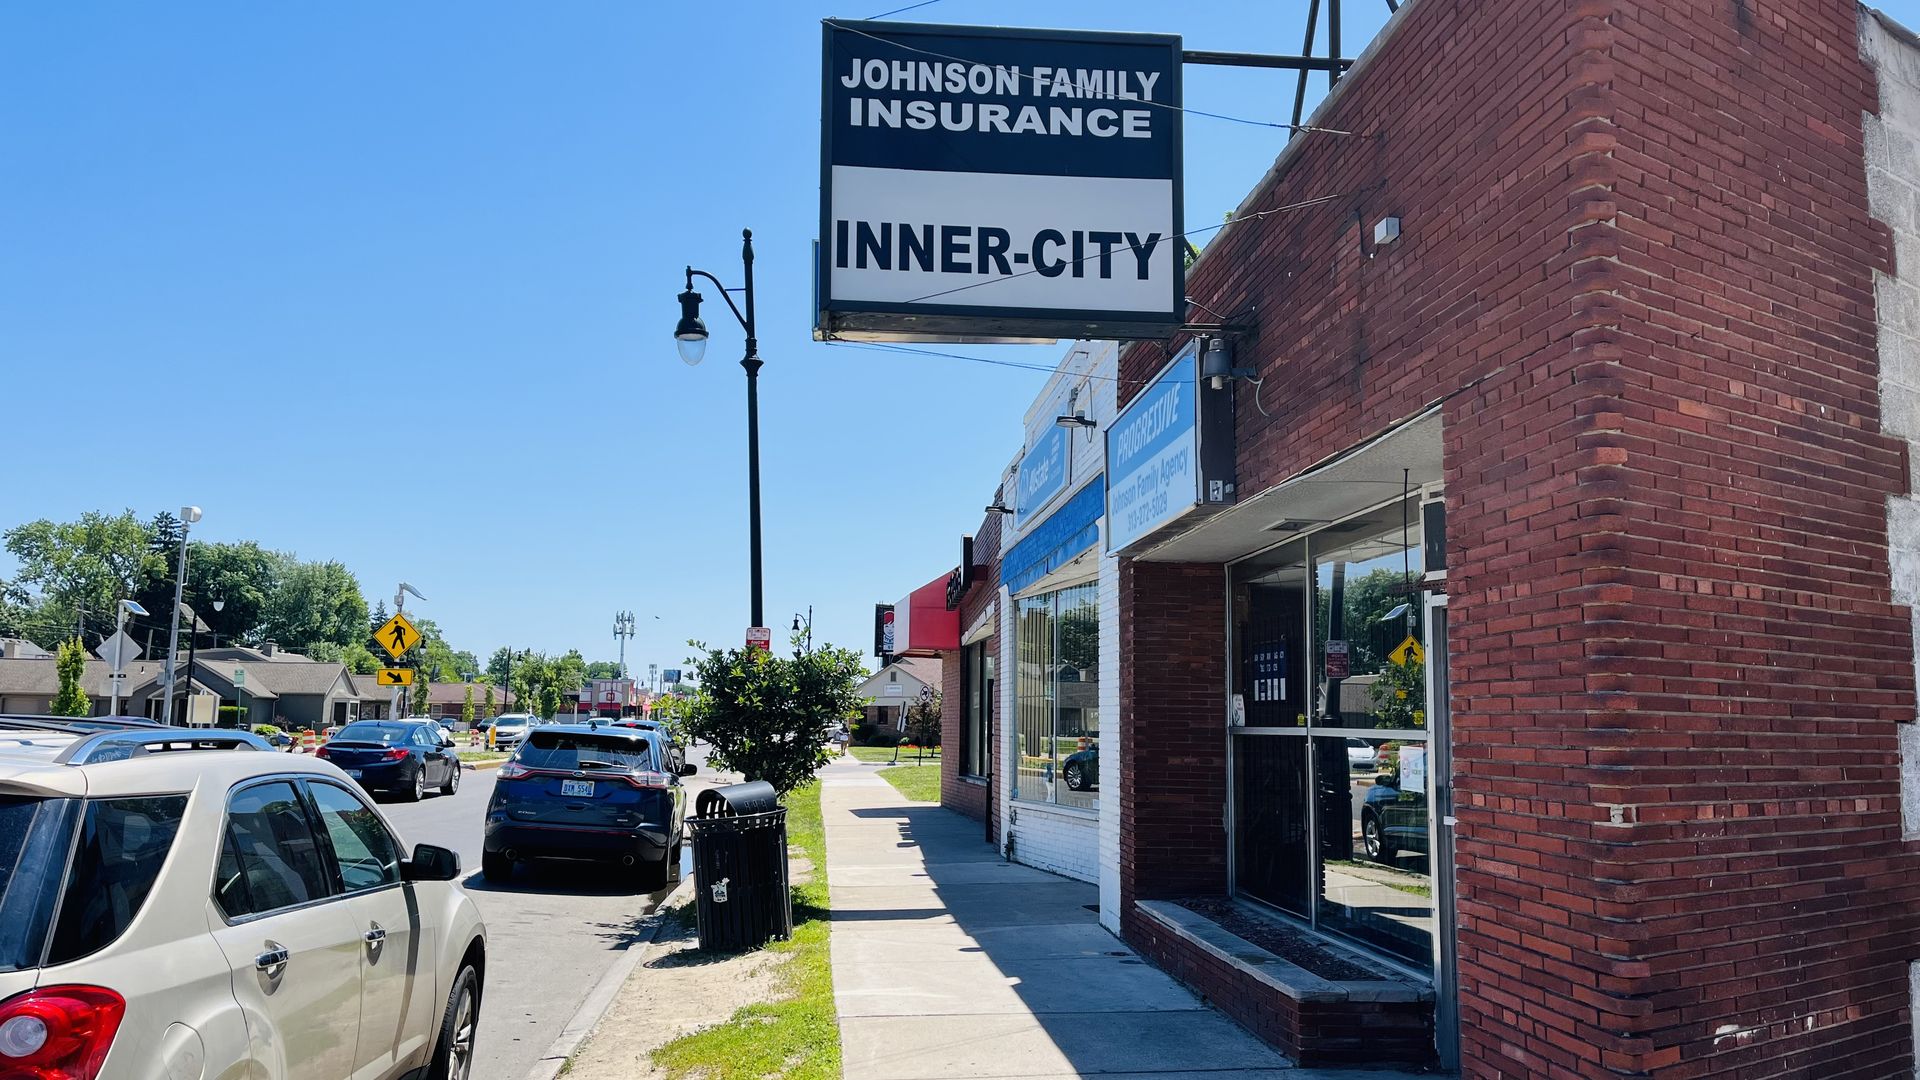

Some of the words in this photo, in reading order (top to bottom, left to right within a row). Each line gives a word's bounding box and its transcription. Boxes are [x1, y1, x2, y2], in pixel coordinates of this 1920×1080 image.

[841, 58, 1020, 96] JOHNSON
[1032, 66, 1161, 101] FAMILY
[850, 98, 1153, 139] INSURANCE
[836, 220, 1162, 281] INNER-CITY
[1117, 382, 1181, 468] PROGRESSIVE
[1112, 484, 1136, 517] Johnson
[1137, 465, 1160, 499] Family
[1160, 446, 1189, 487] Agency
